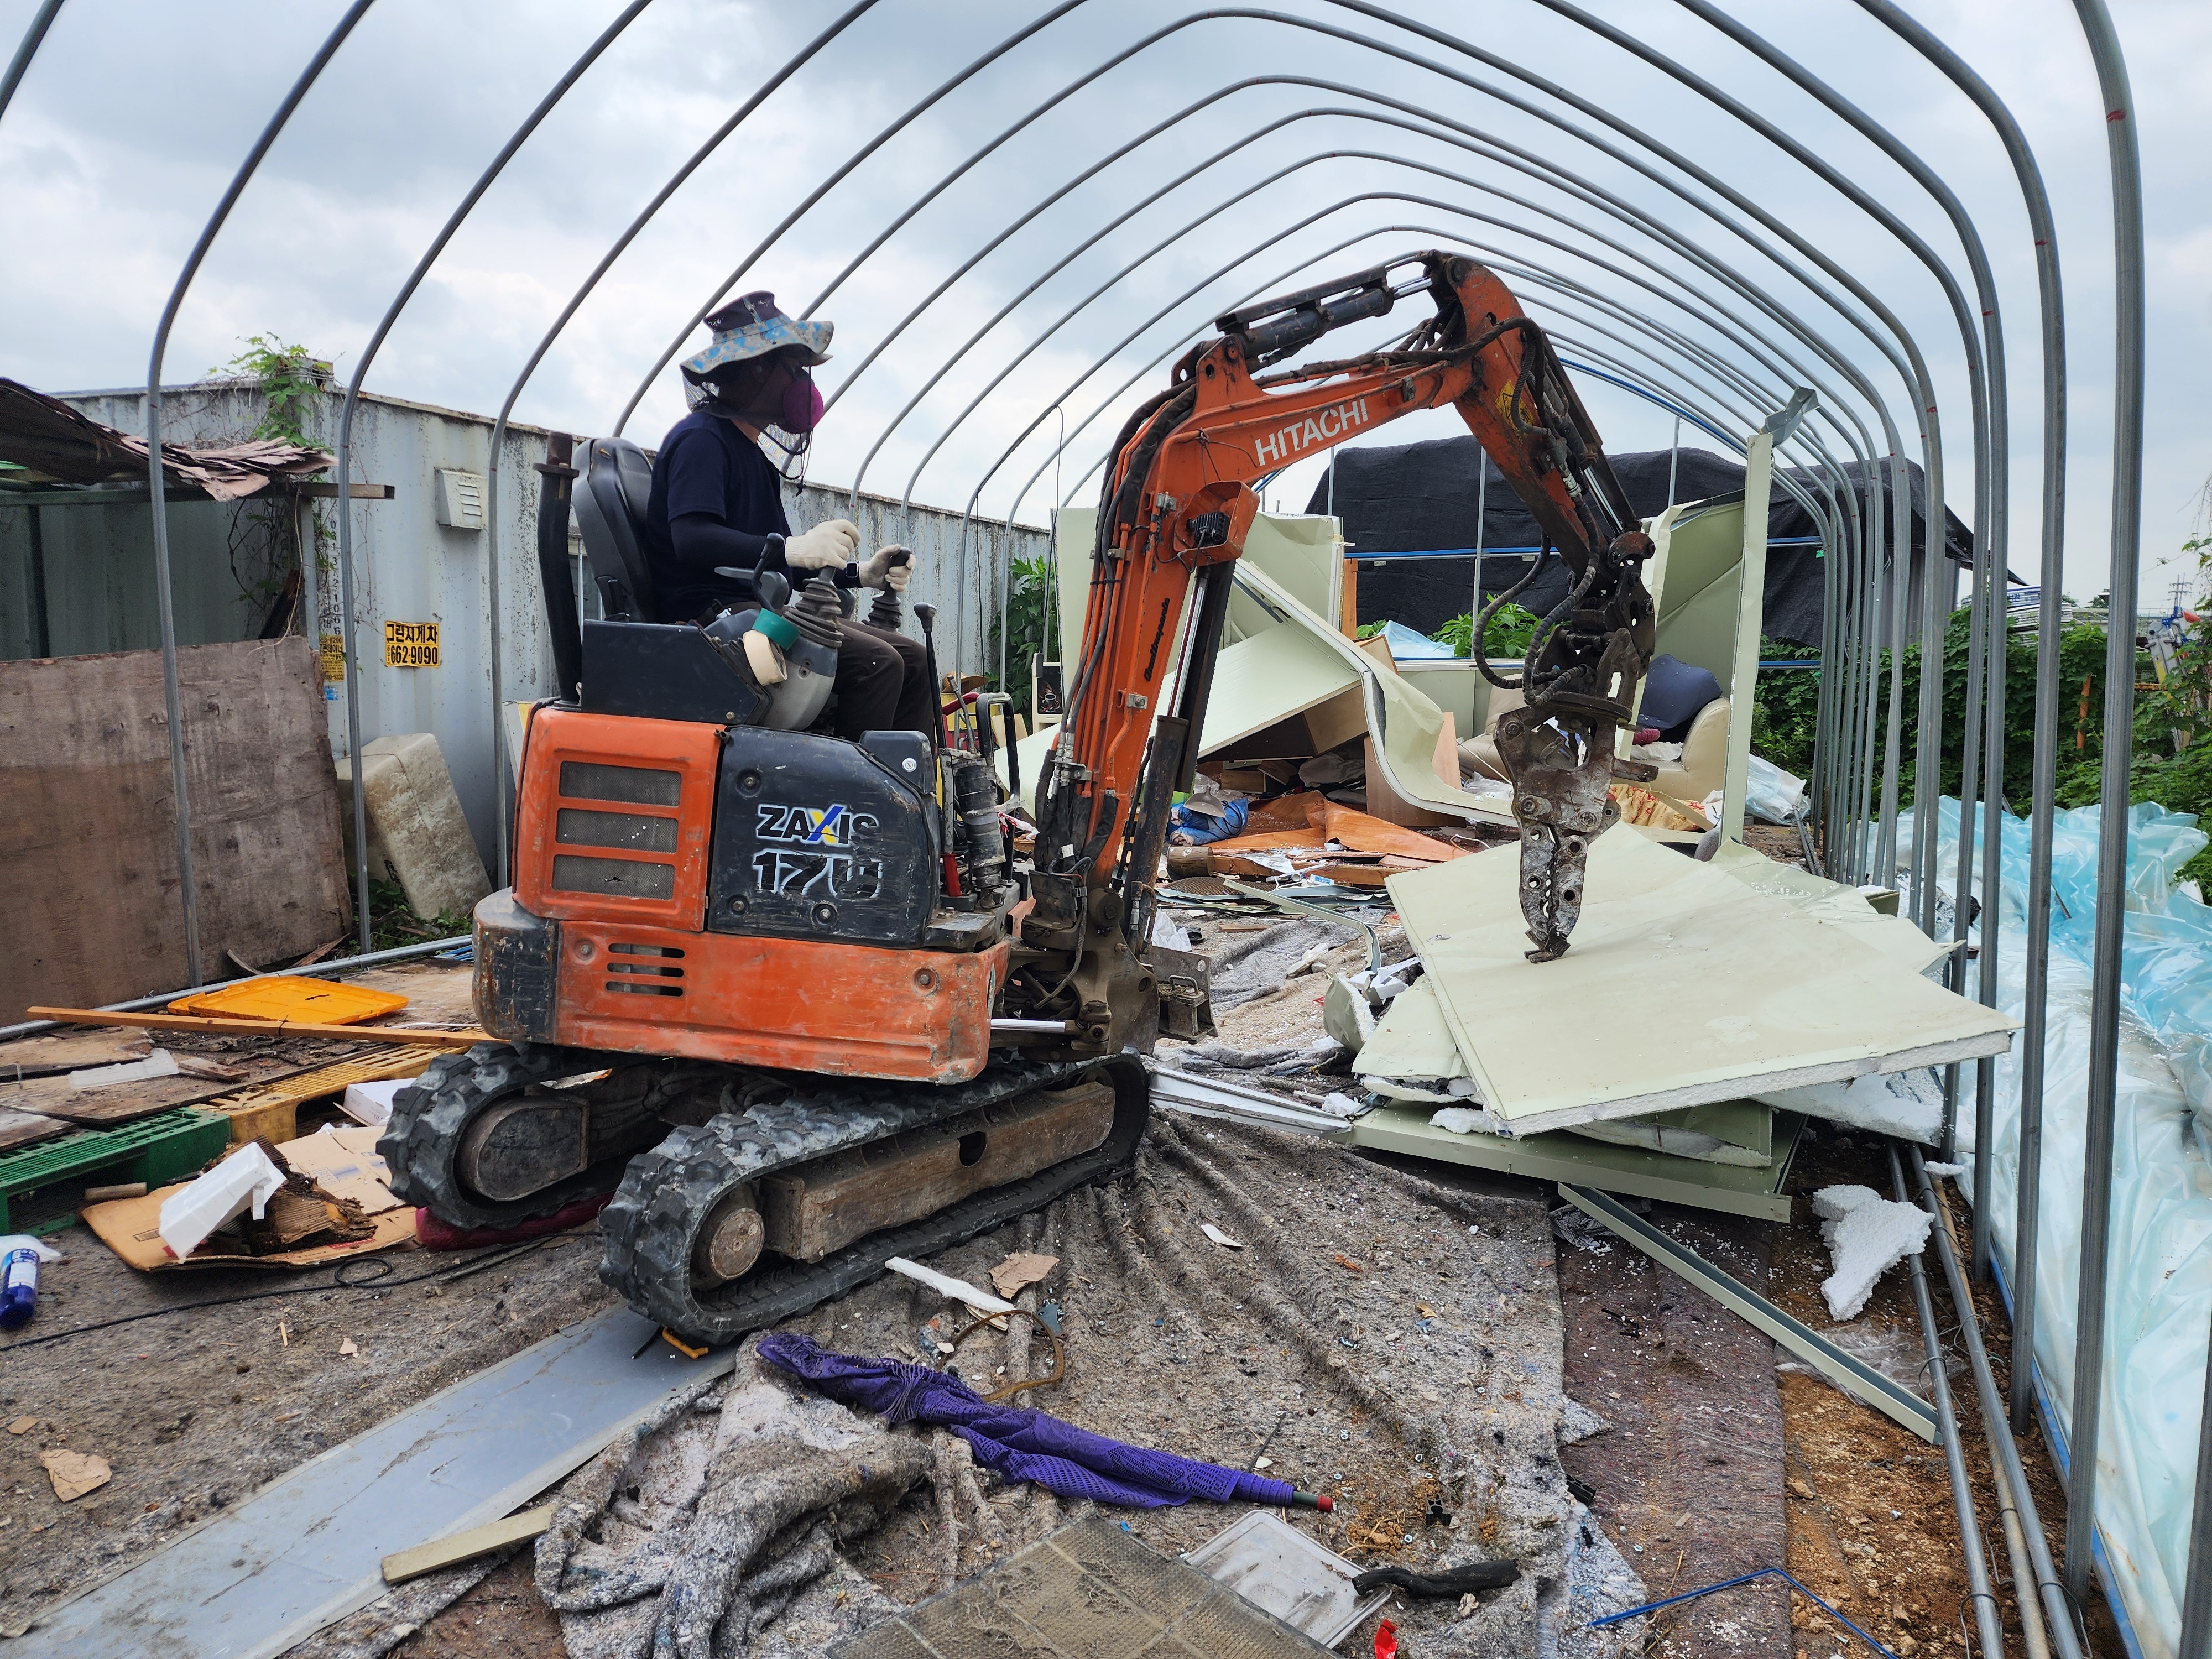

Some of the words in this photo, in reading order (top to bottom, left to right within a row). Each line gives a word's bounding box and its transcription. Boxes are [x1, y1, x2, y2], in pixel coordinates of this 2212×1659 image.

[1255, 398, 1368, 466] HITACHI
[387, 624, 438, 644] 그린지게차
[755, 803, 880, 846] ZAXIS
